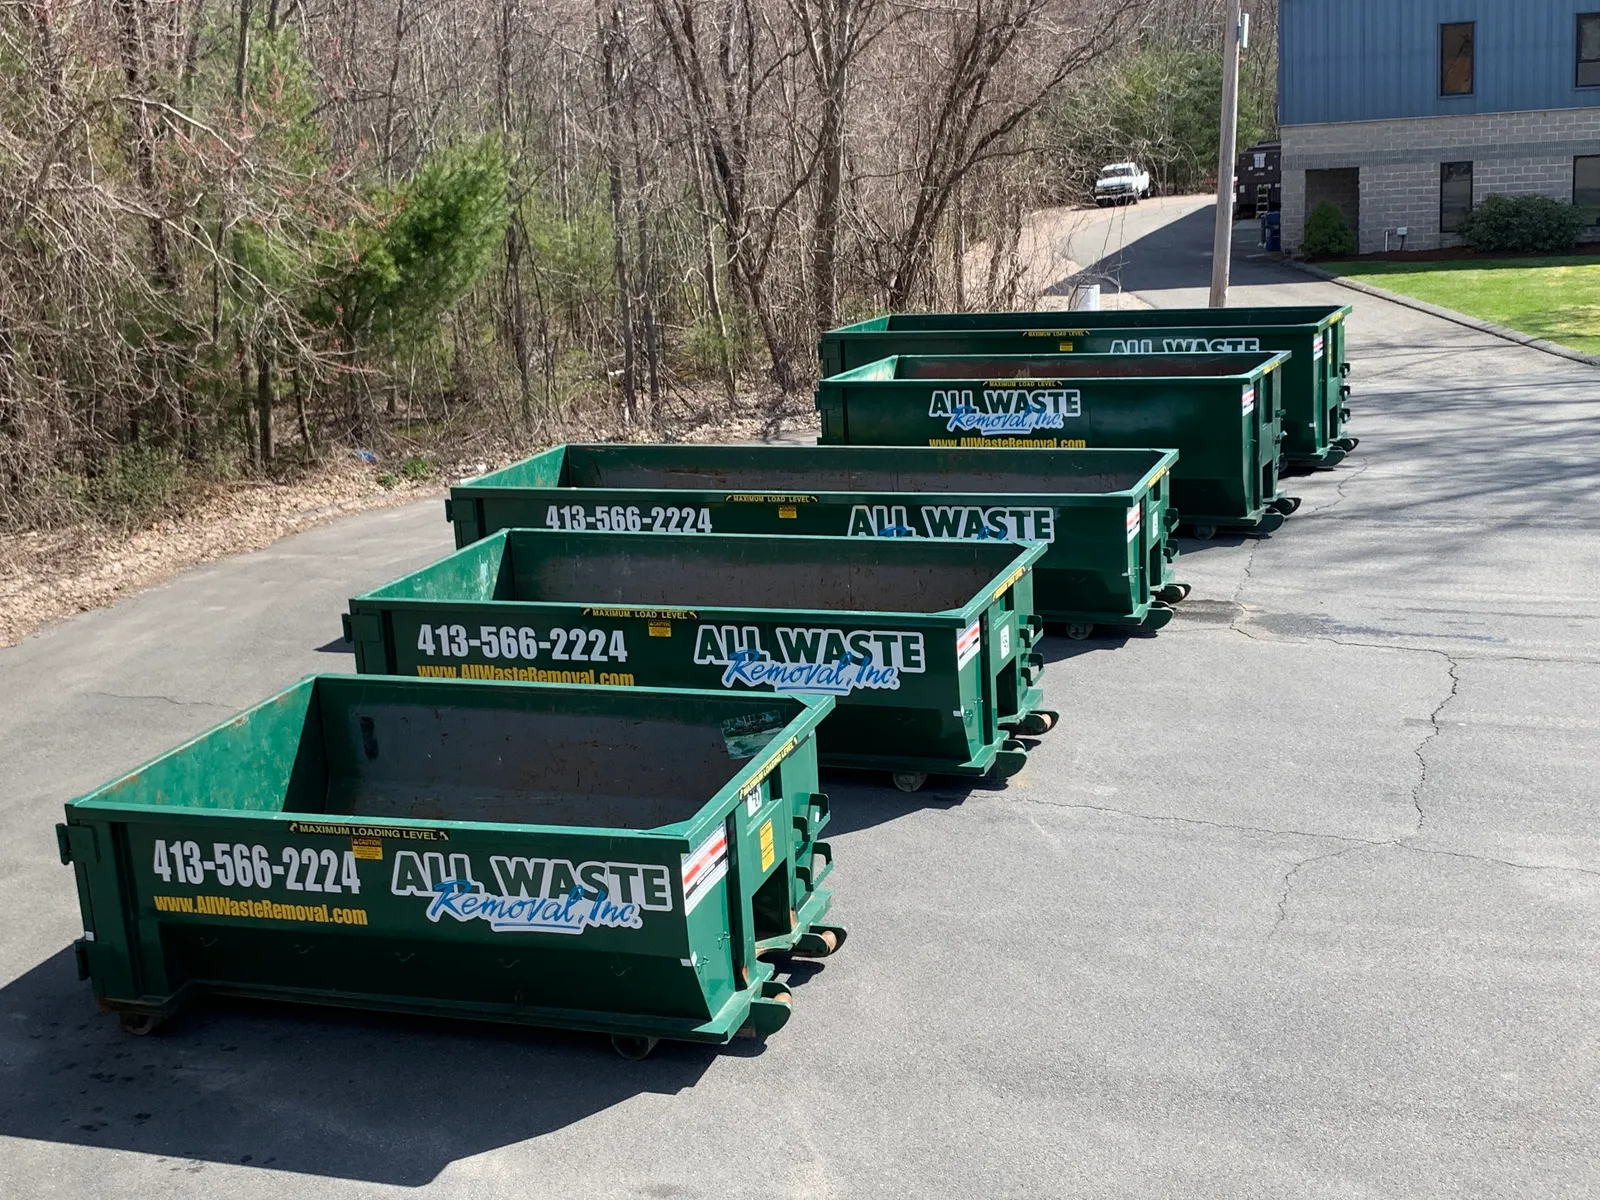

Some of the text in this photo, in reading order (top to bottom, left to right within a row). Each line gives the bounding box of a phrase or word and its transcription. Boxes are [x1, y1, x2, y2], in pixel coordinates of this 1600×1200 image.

[929, 389, 1081, 417] ALL WASTE
[929, 437, 1086, 448] wwwAllWasteRemovalcom
[545, 504, 713, 533] 413-566-2224
[847, 505, 916, 538] ALL
[921, 506, 1055, 543] WASTE
[592, 608, 688, 620] MAXIMUM LOAD LEVEL
[417, 623, 628, 663] 413-566-2224
[694, 624, 770, 665] ALL
[776, 627, 926, 673] WASTE
[417, 664, 635, 686] wwwAllWasteRemovalcom
[855, 655, 900, 688] Inc.
[300, 824, 437, 840] MAXIMUM LOADING LEVEL
[358, 838, 381, 846] CAUTION
[153, 839, 361, 895] 413-566-2224
[391, 851, 485, 897] ALL
[490, 855, 673, 911] WASTE
[154, 895, 368, 925] www.AllWasteRemoval.com
[588, 889, 642, 928] Inc.
